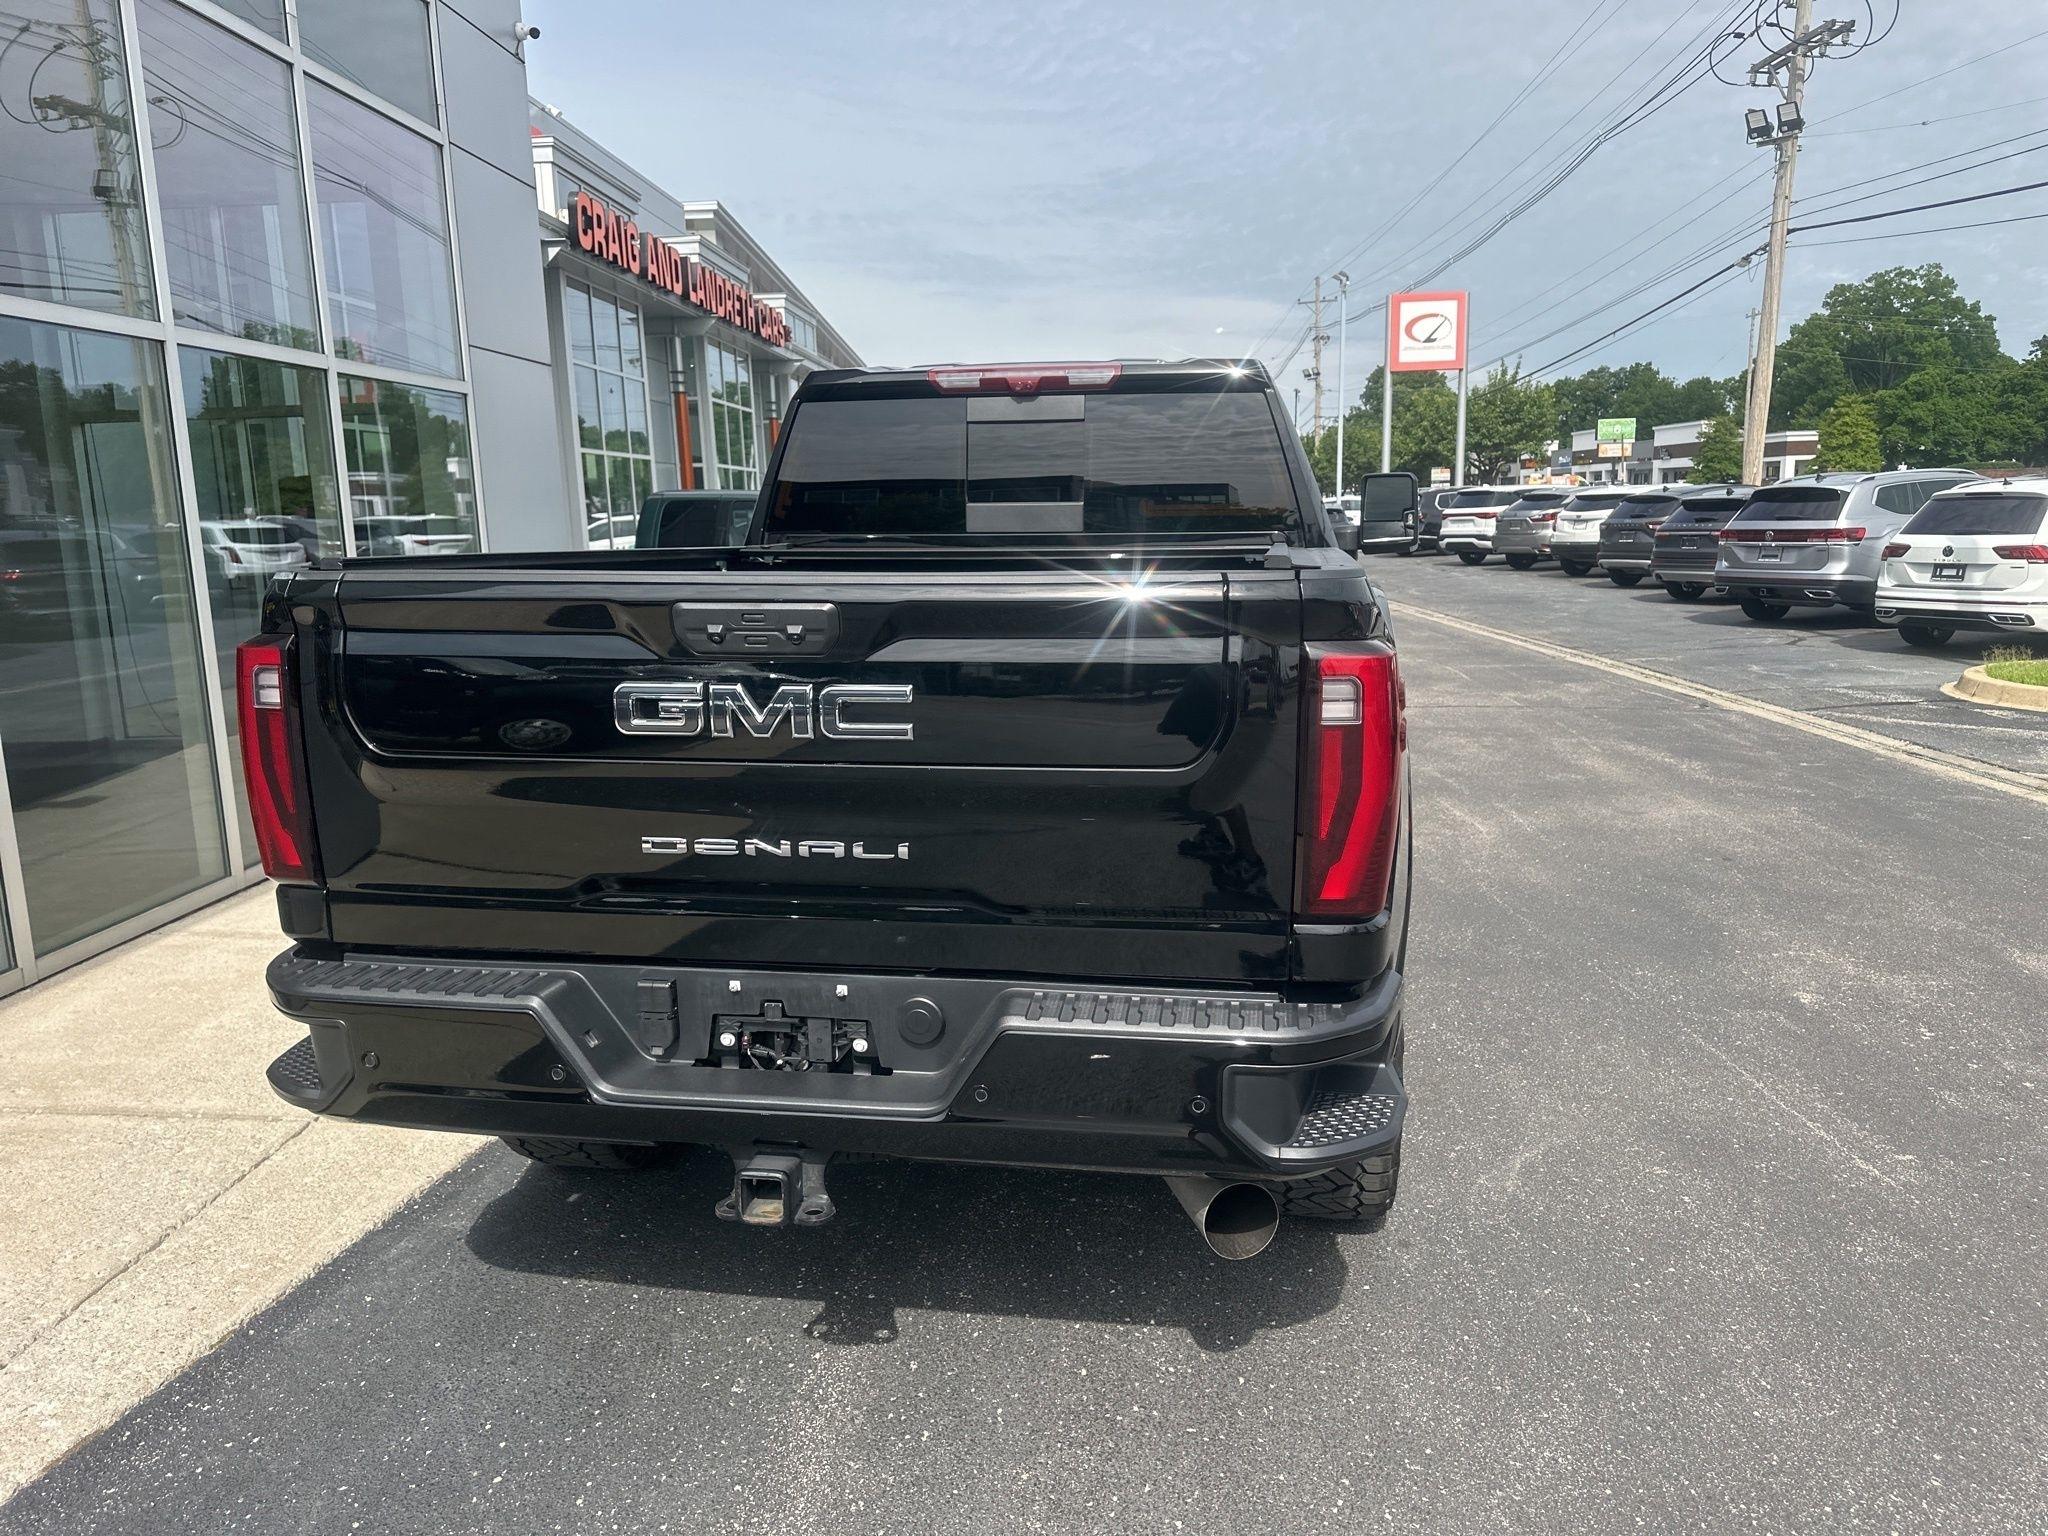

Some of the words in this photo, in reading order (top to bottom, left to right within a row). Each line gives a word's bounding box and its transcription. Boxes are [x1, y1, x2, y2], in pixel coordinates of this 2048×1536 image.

[575, 191, 641, 276] CRAIG
[646, 231, 683, 297] AND
[687, 256, 757, 334] LANDRETH
[757, 298, 786, 348] CARS
[613, 682, 914, 741] GMC
[641, 836, 910, 860] DENALI
